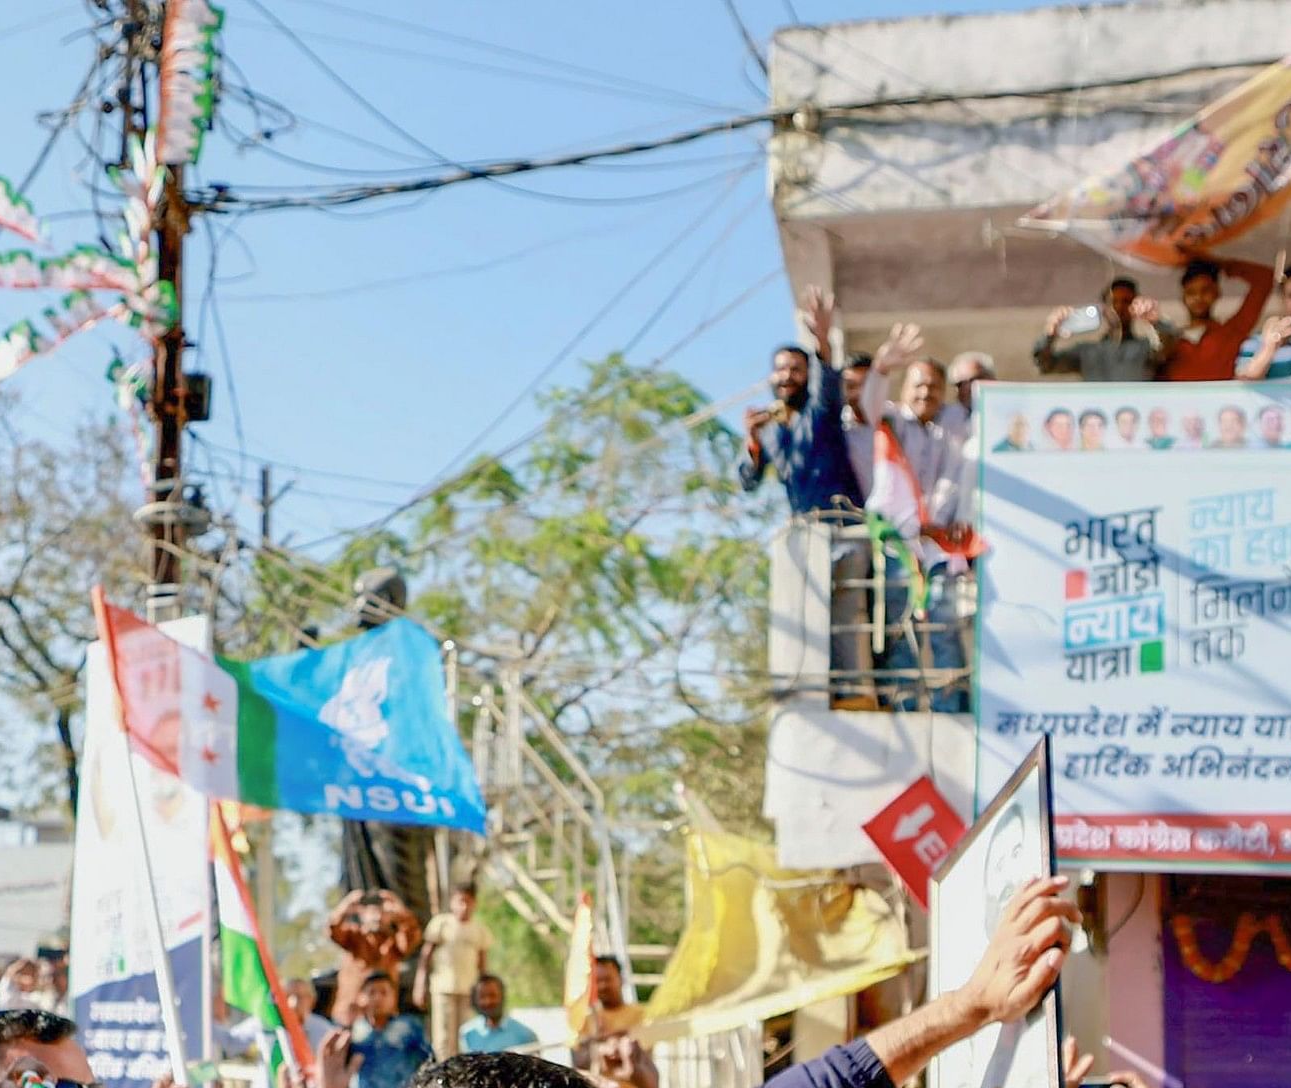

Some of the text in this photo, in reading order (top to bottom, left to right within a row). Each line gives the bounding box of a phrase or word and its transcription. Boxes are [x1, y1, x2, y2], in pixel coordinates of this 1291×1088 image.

[1188, 488, 1276, 529] न्याय
[1064, 506, 1163, 560] भारत
[1190, 533, 1232, 568] का
[1066, 599, 1163, 648] न्याय
[1190, 623, 1248, 664] तक
[1065, 645, 1133, 682] यात्रा
[996, 705, 1131, 738] मध्यप्रदेश
[1137, 705, 1169, 736] में
[1170, 713, 1245, 738] न्याय
[1065, 744, 1154, 779] हार्दिक
[323, 783, 456, 818] NSUI
[1055, 819, 1112, 850] प्रदेश
[1114, 819, 1191, 852] कांग्रेस
